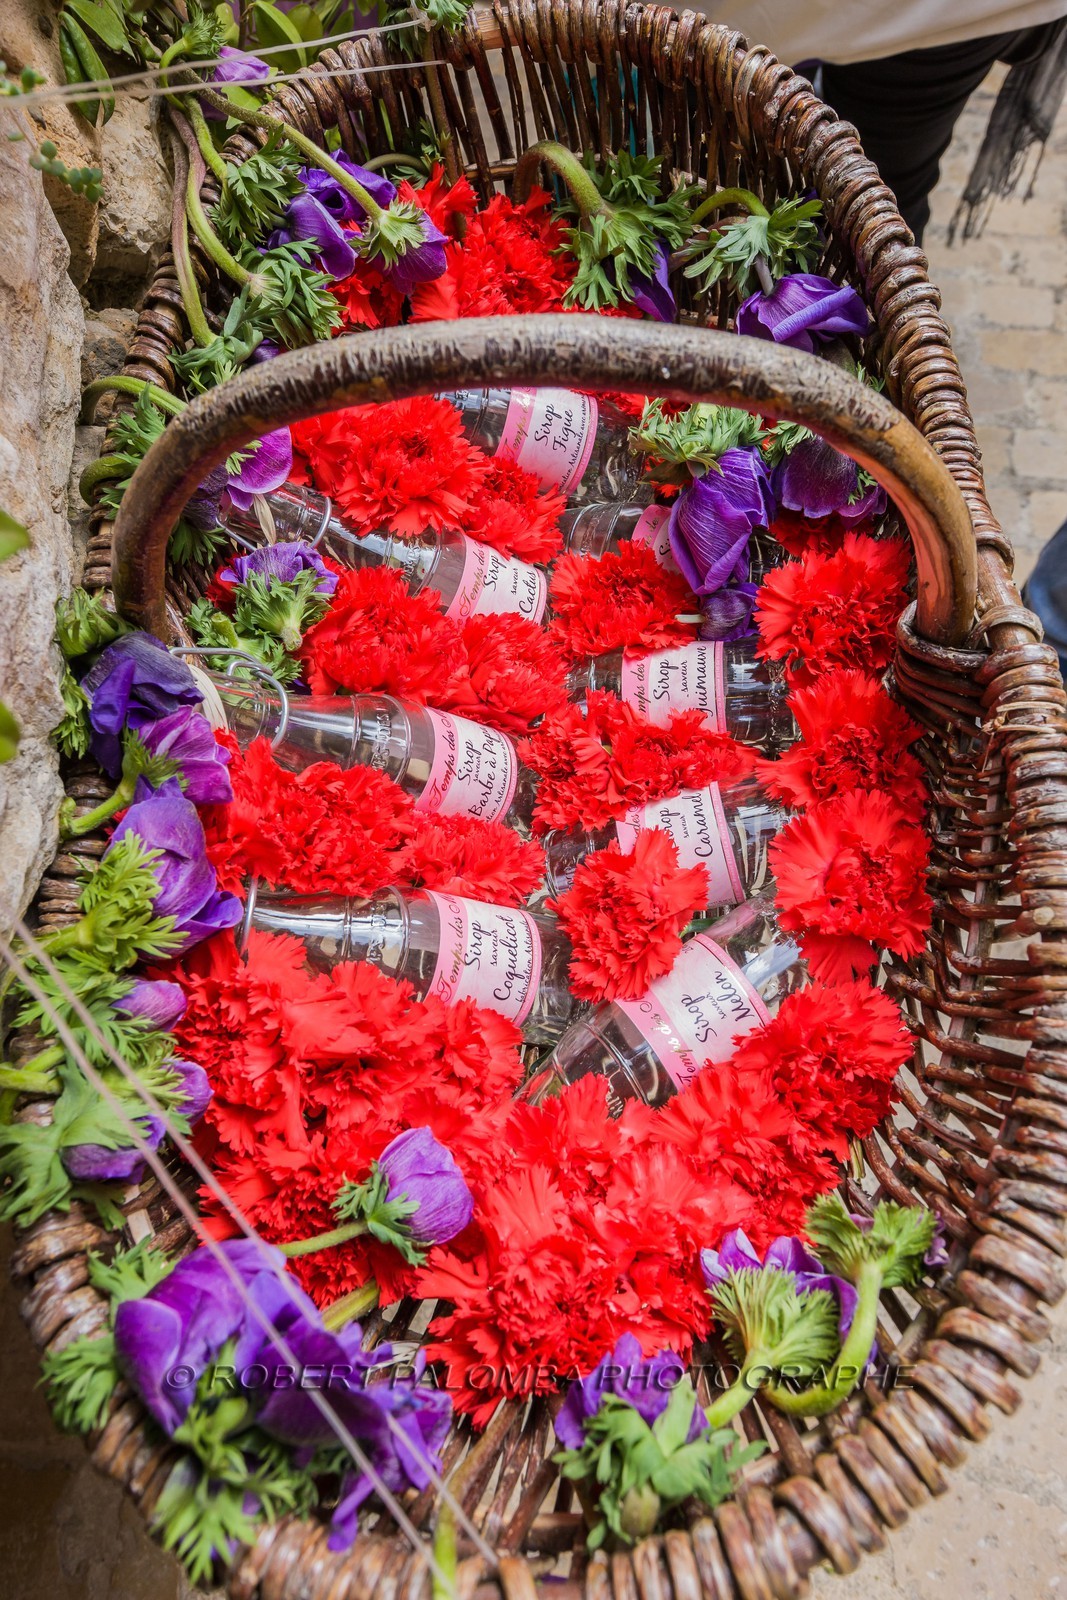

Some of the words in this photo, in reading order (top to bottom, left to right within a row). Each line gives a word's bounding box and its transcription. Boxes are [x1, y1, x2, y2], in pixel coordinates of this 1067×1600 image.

[535, 404, 562, 446] Sirop
[552, 409, 579, 453] Figue
[459, 567, 485, 617] Temps
[484, 555, 507, 591] Sirop
[519, 570, 536, 613] Cactus
[630, 663, 645, 682] des
[653, 659, 679, 702] Sirop
[634, 685, 651, 713] mps
[442, 730, 456, 751] des
[458, 739, 482, 785] Sirop
[429, 755, 457, 807] Temps
[468, 773, 496, 816] Barbe
[485, 759, 497, 772] à
[473, 755, 482, 782] saveur
[682, 793, 714, 857] Caramel
[682, 815, 690, 838] saveur
[448, 920, 464, 939] des
[464, 920, 491, 970] Sirop
[490, 928, 498, 967] saveur
[436, 943, 466, 1002] Temps
[493, 915, 524, 1001] Coquelicot
[705, 991, 727, 1020] saveur
[714, 970, 755, 1022] Melon
[680, 993, 717, 1043] Sirop
